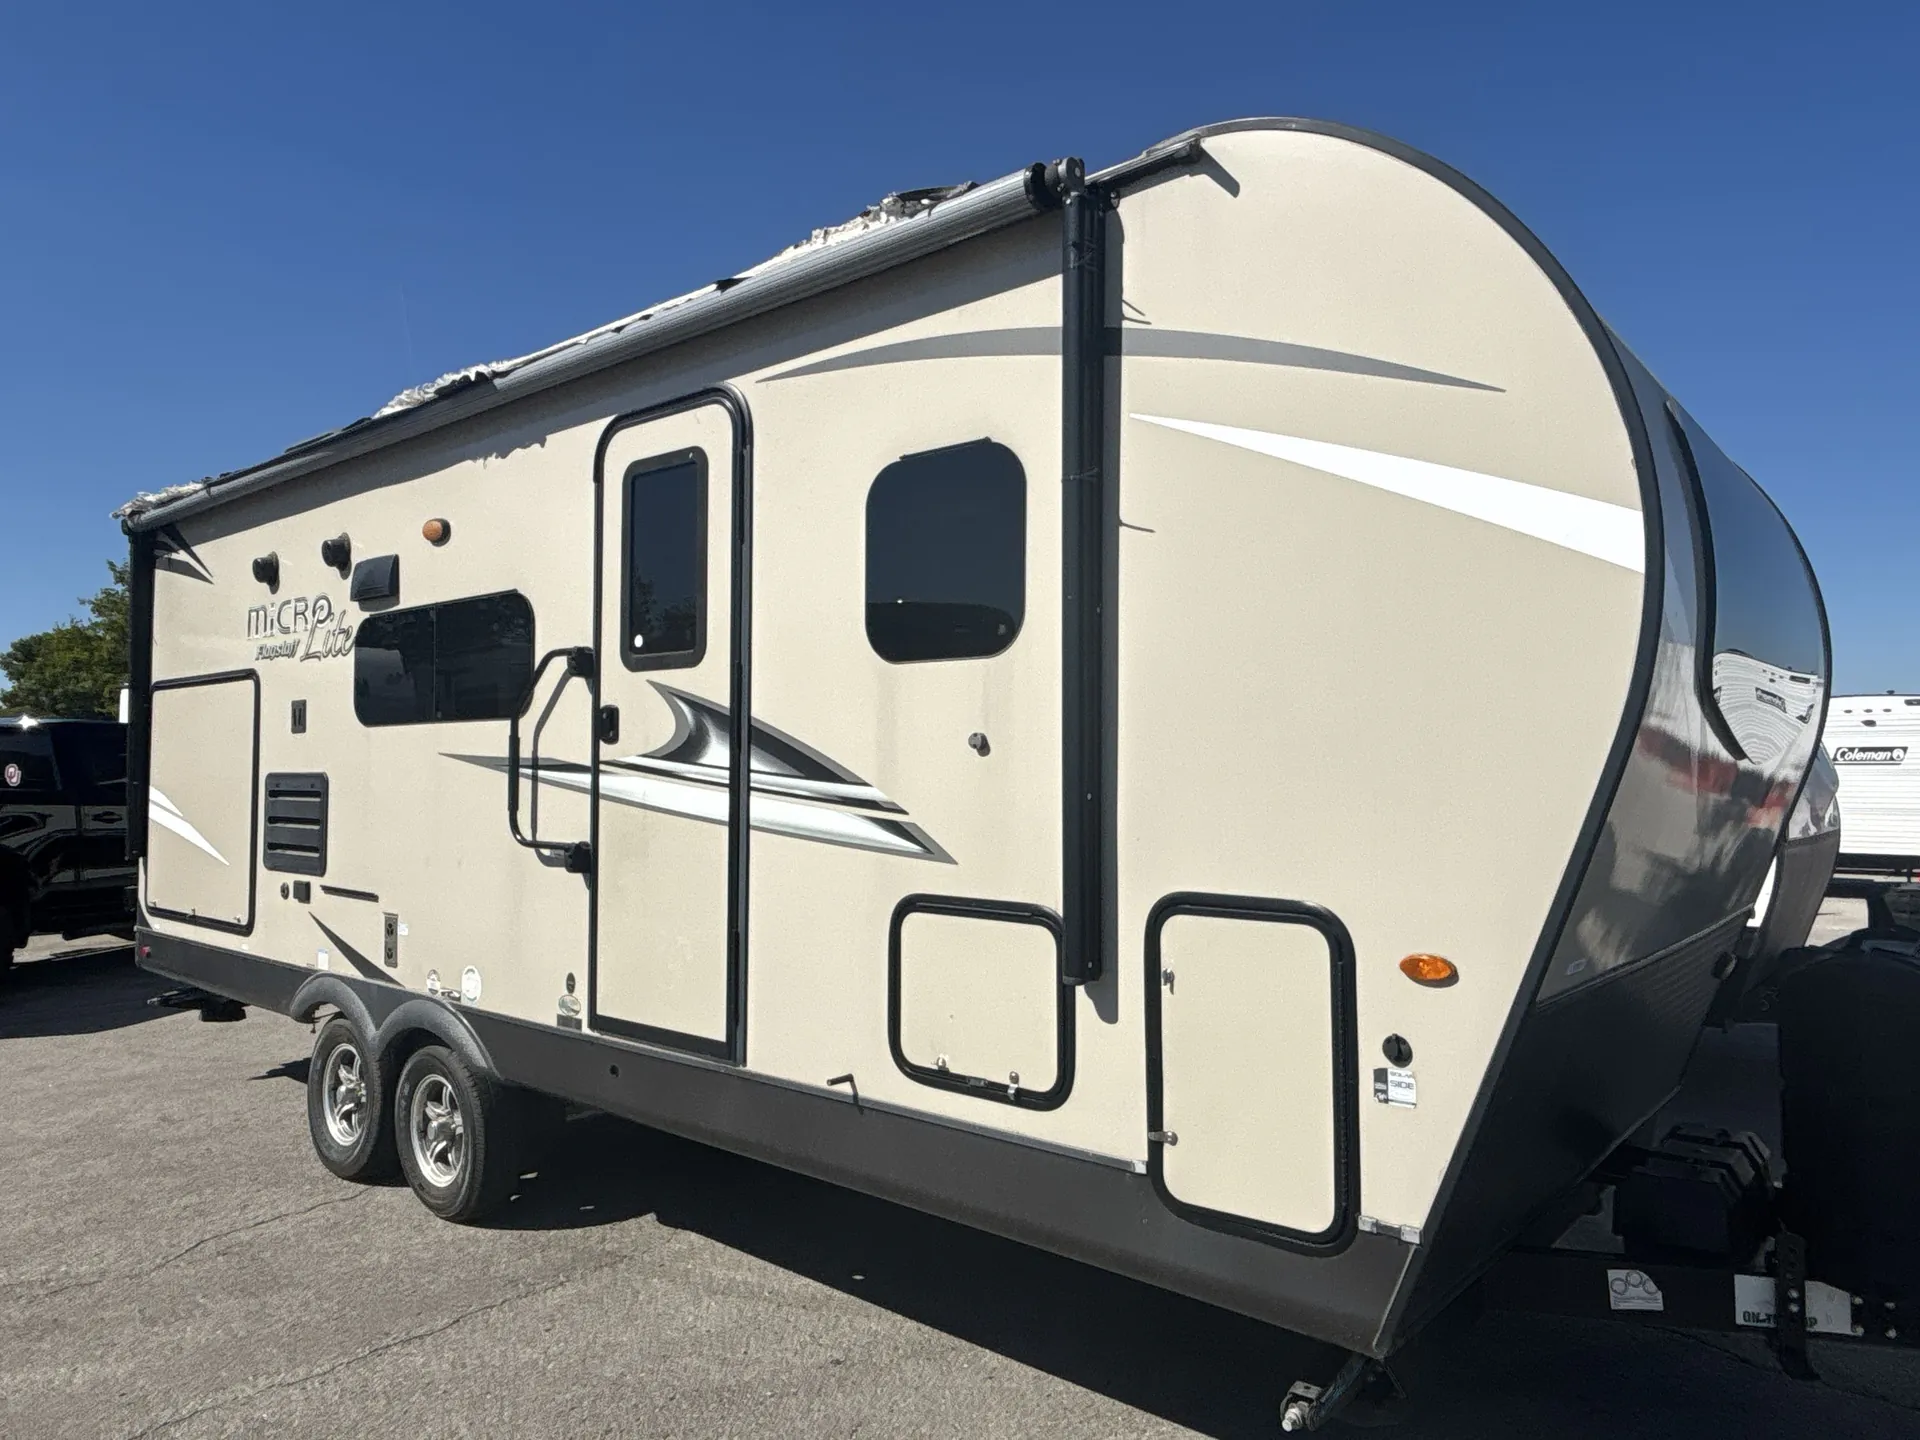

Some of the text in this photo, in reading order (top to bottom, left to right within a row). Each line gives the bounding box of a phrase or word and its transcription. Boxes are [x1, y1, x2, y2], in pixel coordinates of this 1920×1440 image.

[300, 608, 354, 662] Lite
[1836, 747, 1892, 761] Coleman
[1390, 1080, 1415, 1090] SIDE
